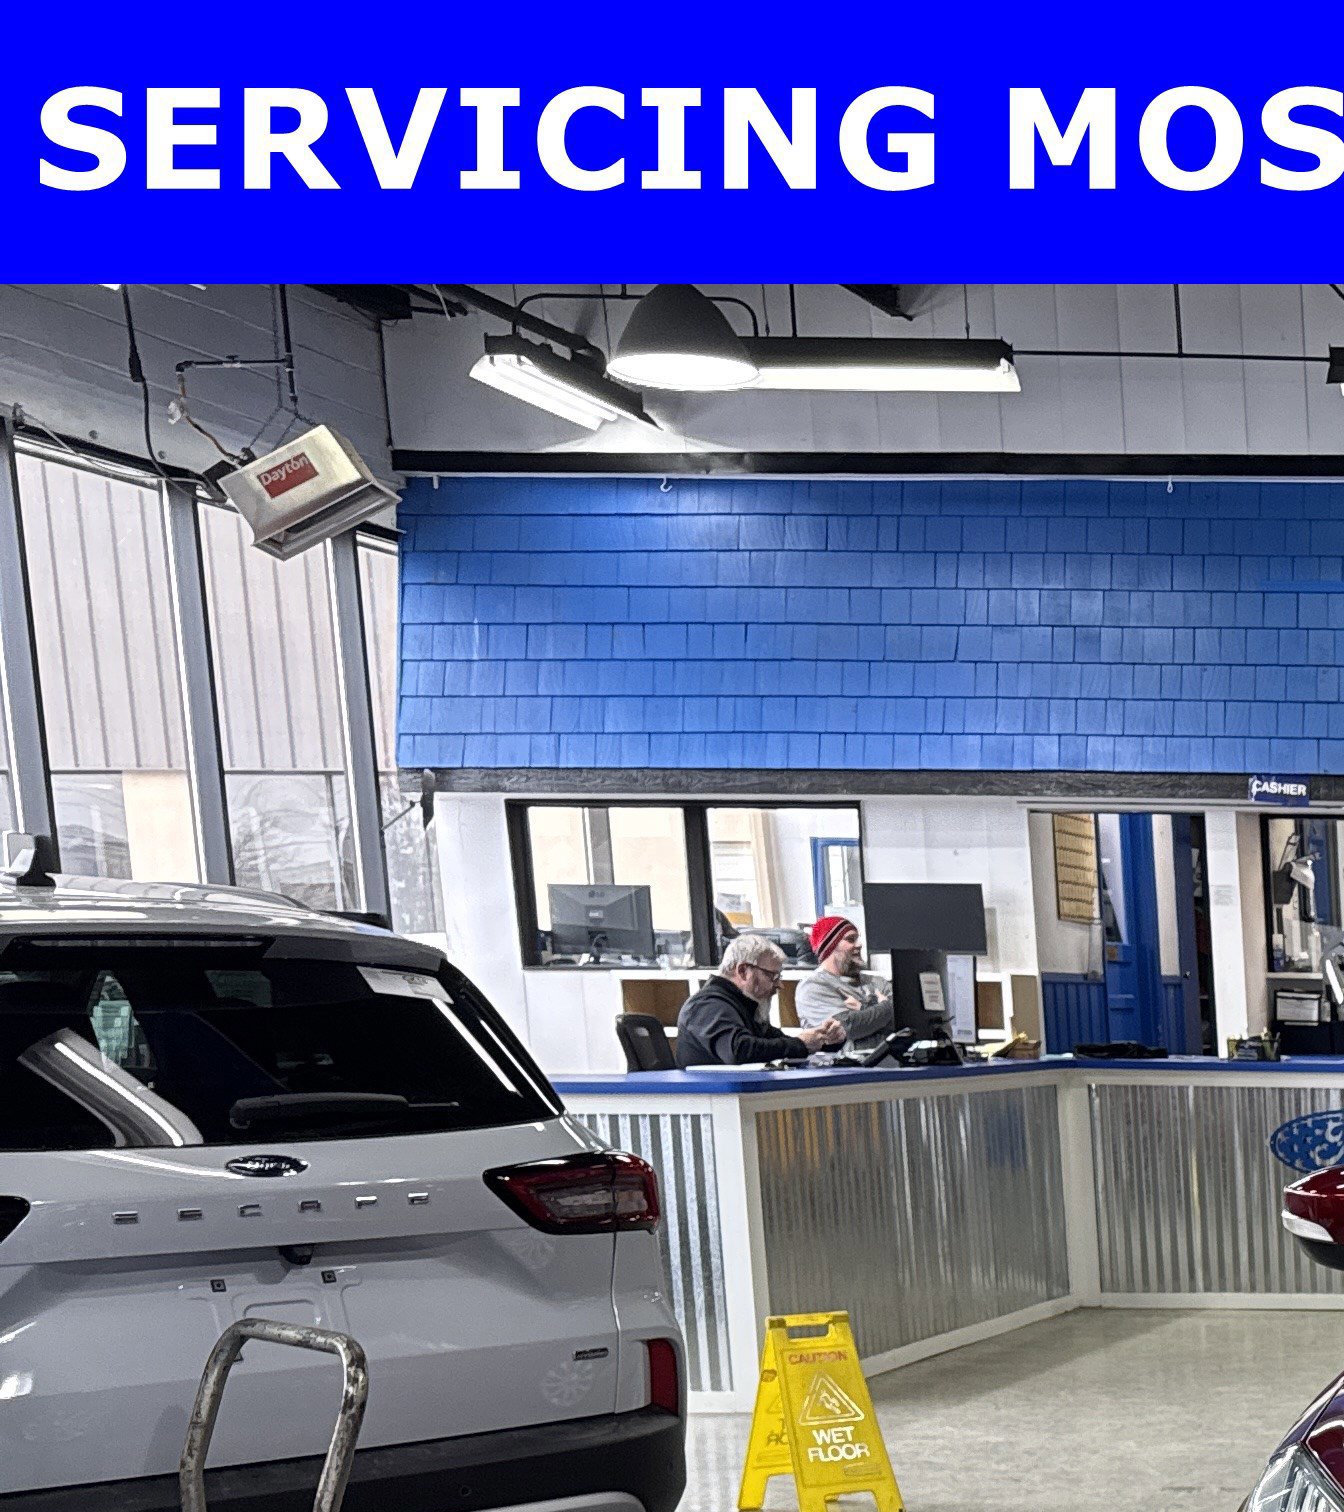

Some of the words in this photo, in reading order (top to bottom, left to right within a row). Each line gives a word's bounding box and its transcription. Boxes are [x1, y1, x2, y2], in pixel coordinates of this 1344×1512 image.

[260, 455, 309, 486] Dayton
[1252, 780, 1307, 796] CASHIER
[112, 1192, 429, 1223] ESCAPE
[788, 1351, 848, 1366] CAUTION
[812, 1426, 855, 1446] WET
[808, 1443, 871, 1462] FLOOR
